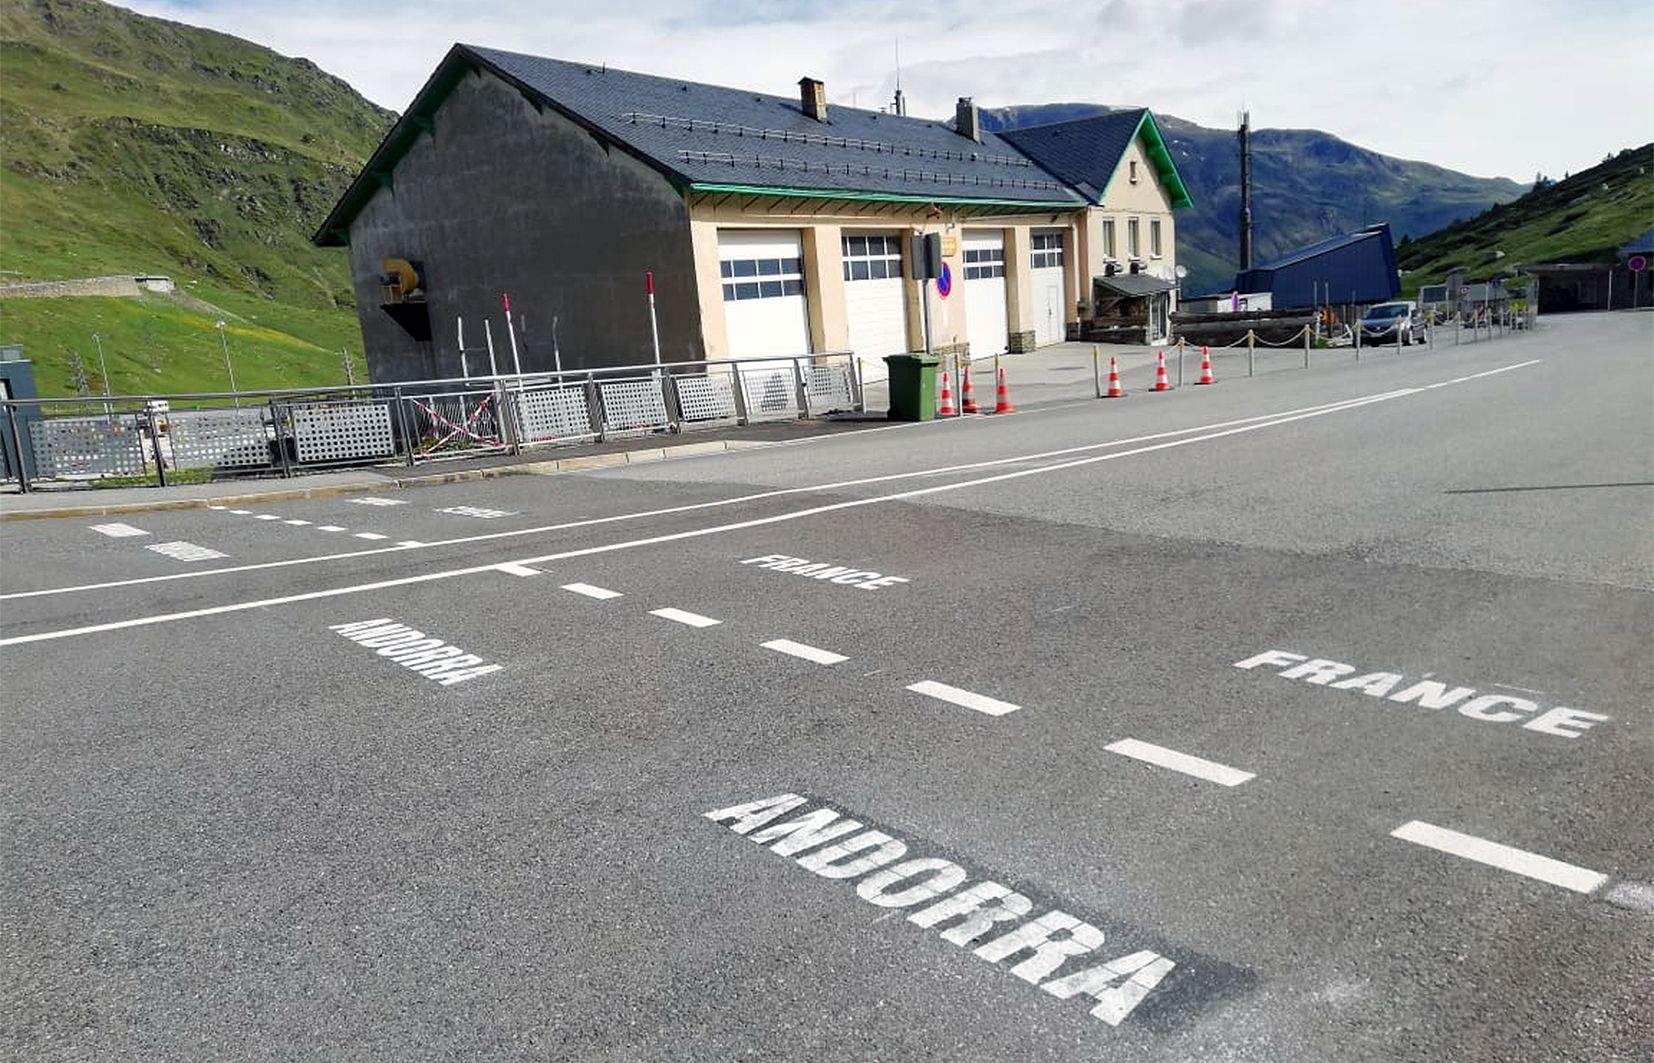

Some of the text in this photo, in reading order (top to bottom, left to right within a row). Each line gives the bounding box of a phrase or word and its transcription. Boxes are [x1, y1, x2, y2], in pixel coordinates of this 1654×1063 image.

[739, 554, 911, 590] FRANCE
[328, 617, 504, 686] ANDORRA
[1232, 650, 1610, 739] FRANCE
[701, 793, 1176, 1026] ANDORRA
